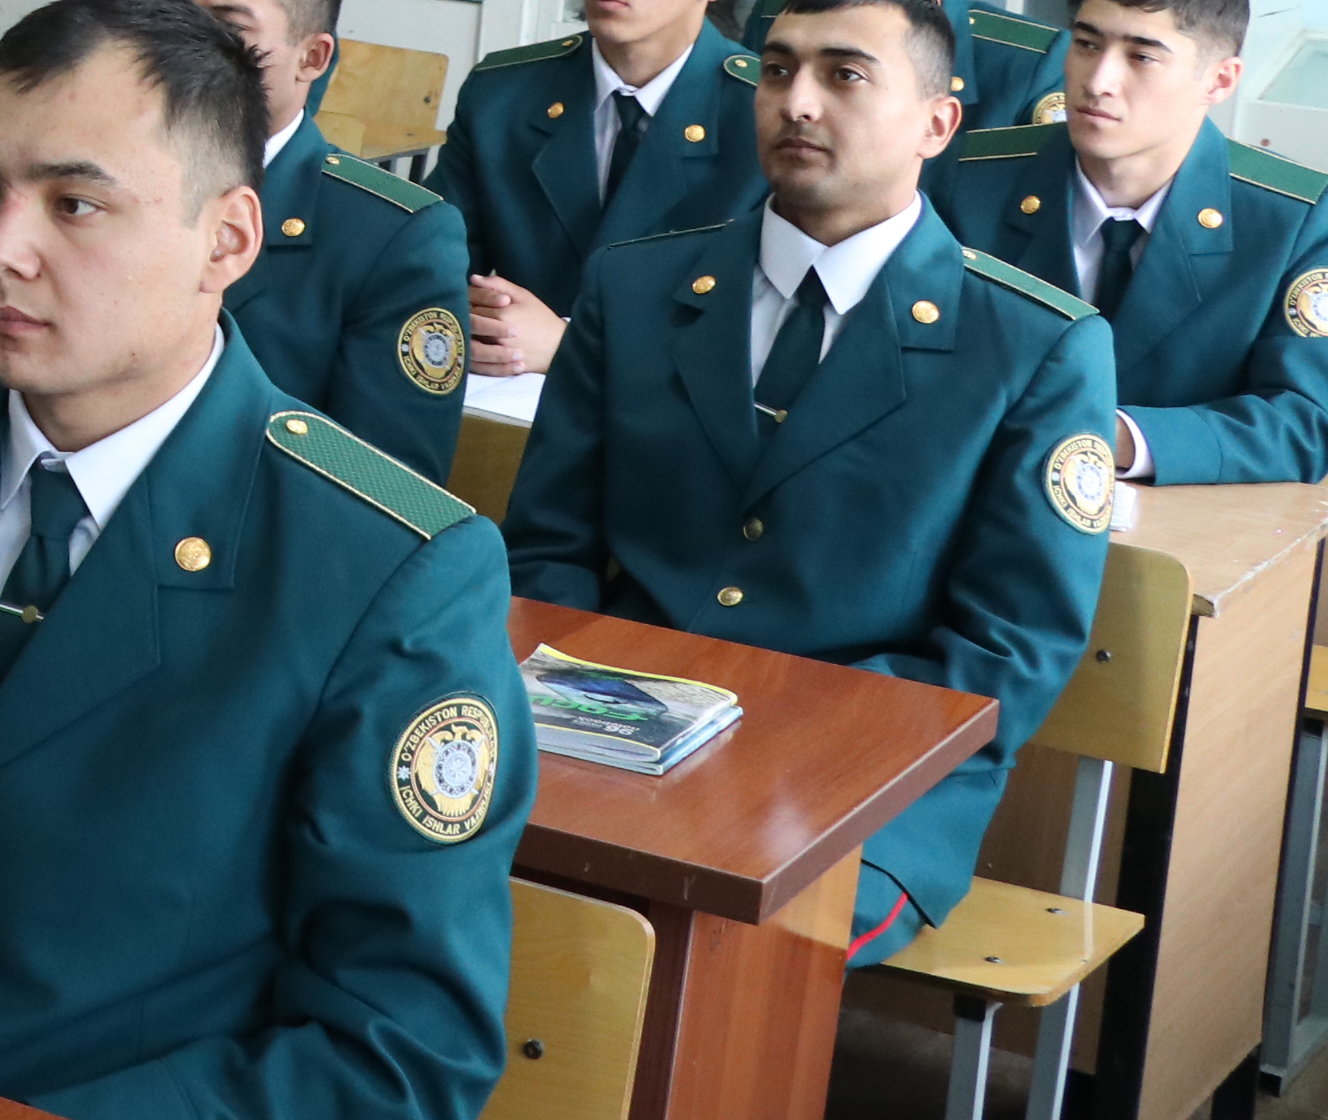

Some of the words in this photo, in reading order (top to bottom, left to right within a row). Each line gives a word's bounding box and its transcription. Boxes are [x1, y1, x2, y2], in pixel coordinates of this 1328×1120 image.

[401, 706, 458, 762] O'ZBEKISTON
[604, 725, 634, 735] 96
[400, 785, 423, 818] ICHKI
[422, 815, 460, 834] ISHLAR
